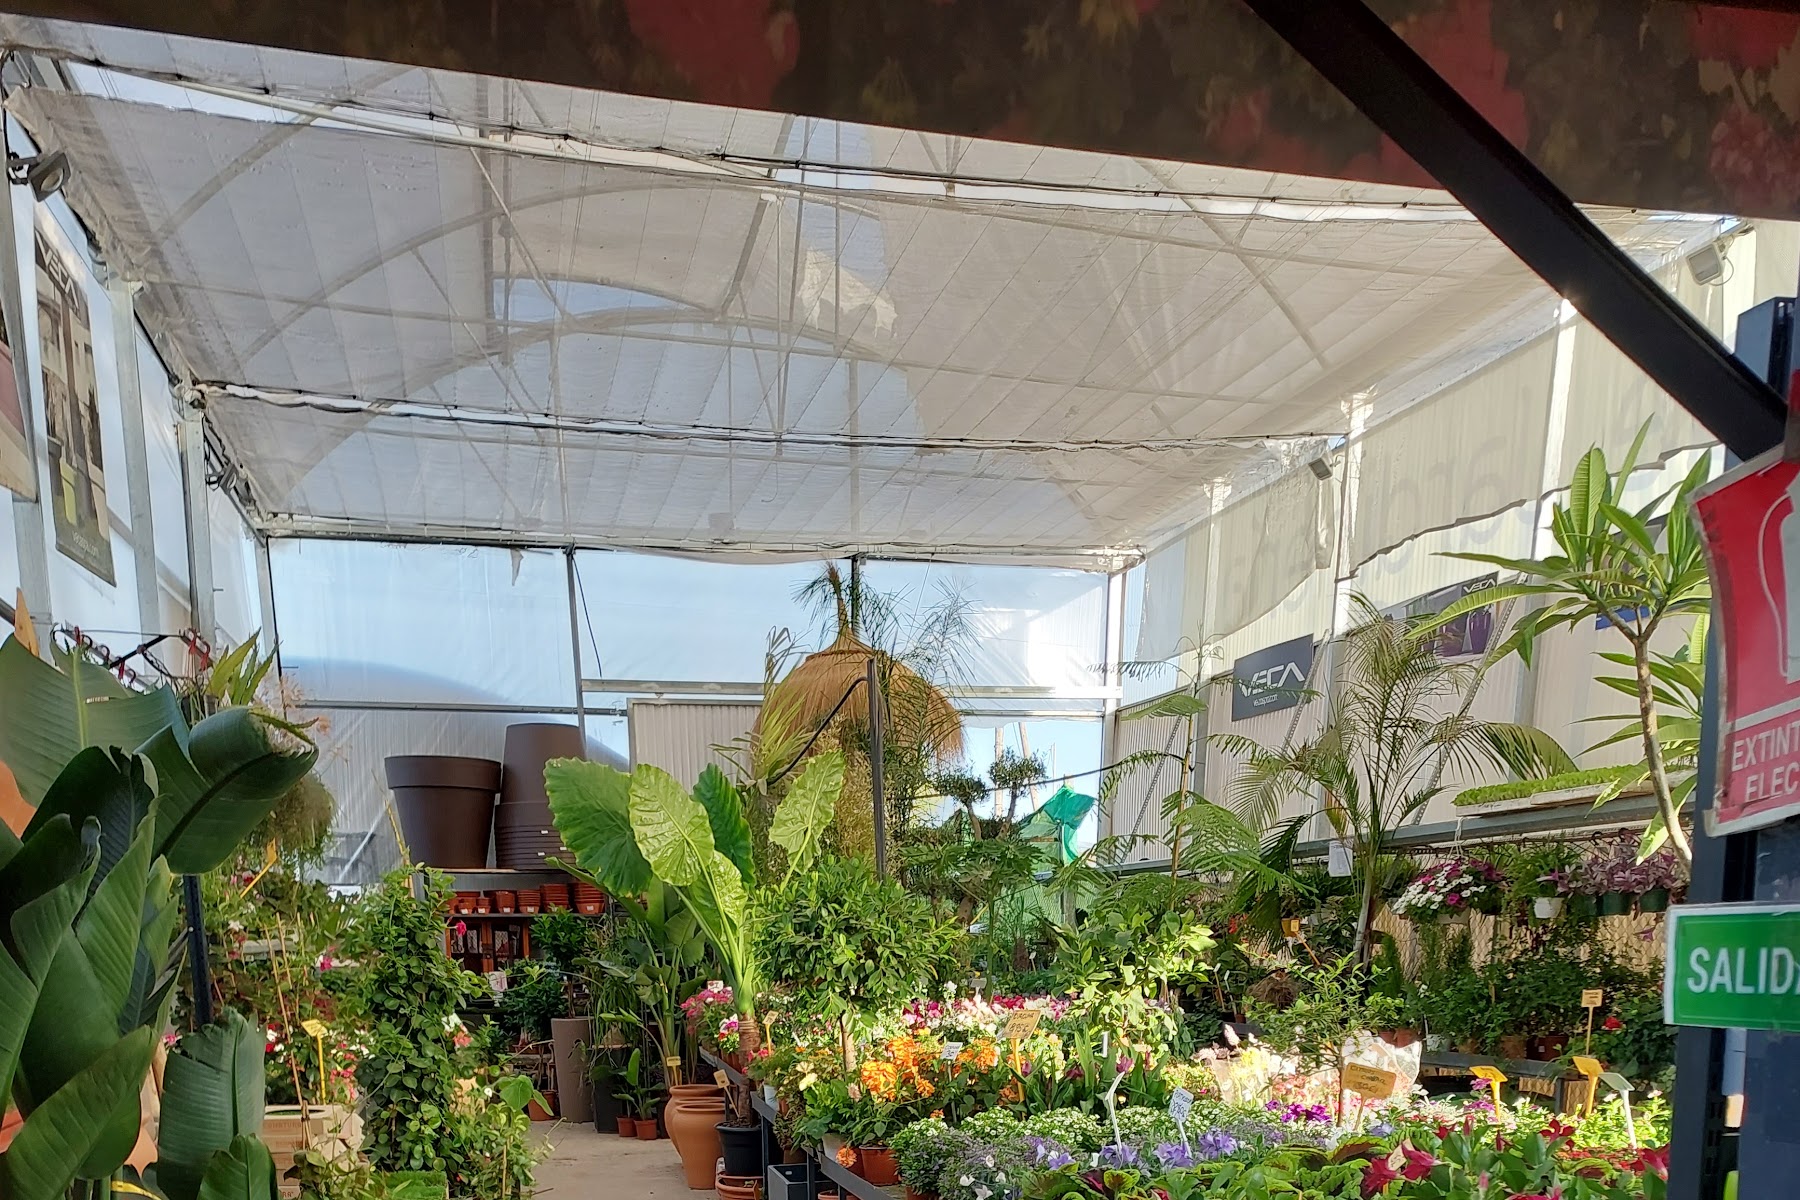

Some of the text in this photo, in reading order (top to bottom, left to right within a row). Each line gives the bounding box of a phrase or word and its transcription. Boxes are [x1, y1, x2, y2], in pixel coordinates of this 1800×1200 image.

[1463, 578, 1496, 593] VECA
[1238, 661, 1305, 697] VECA
[1686, 946, 1800, 995] SALID
